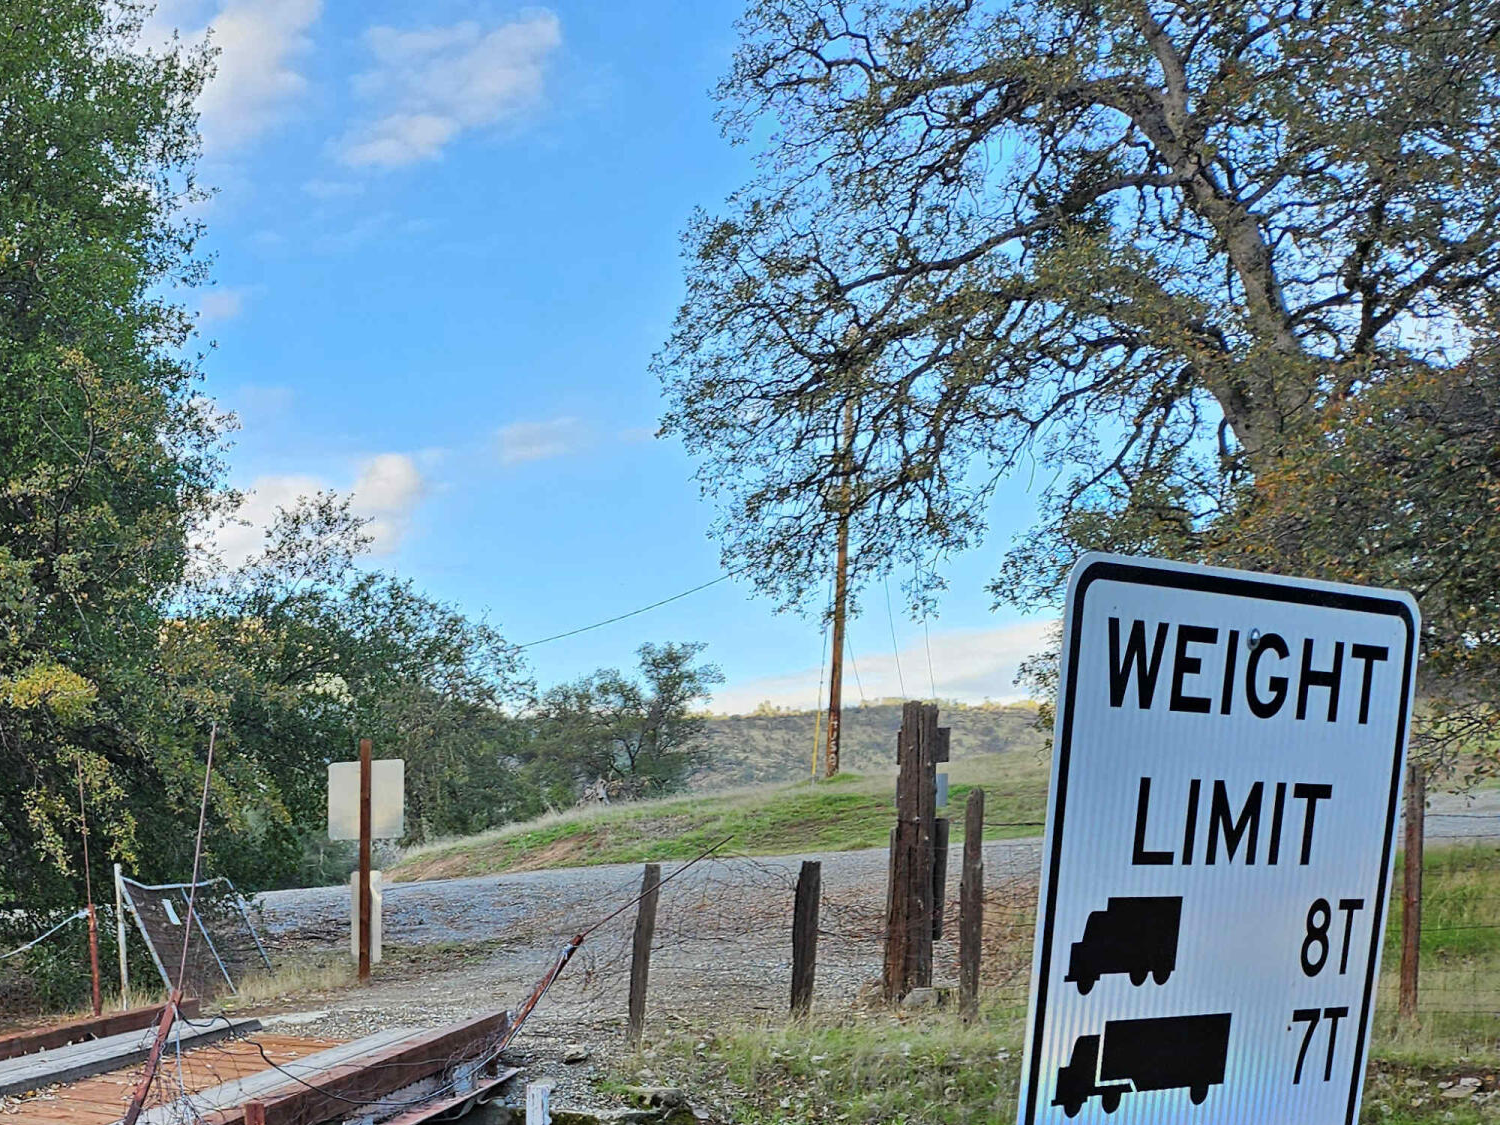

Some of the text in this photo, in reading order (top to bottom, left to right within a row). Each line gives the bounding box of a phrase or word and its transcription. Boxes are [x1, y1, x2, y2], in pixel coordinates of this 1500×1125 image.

[1108, 617, 1388, 724] WEIGHT
[1132, 777, 1332, 866] LIMIT
[1300, 898, 1364, 977] 8T
[1292, 1007, 1348, 1085] 7T
